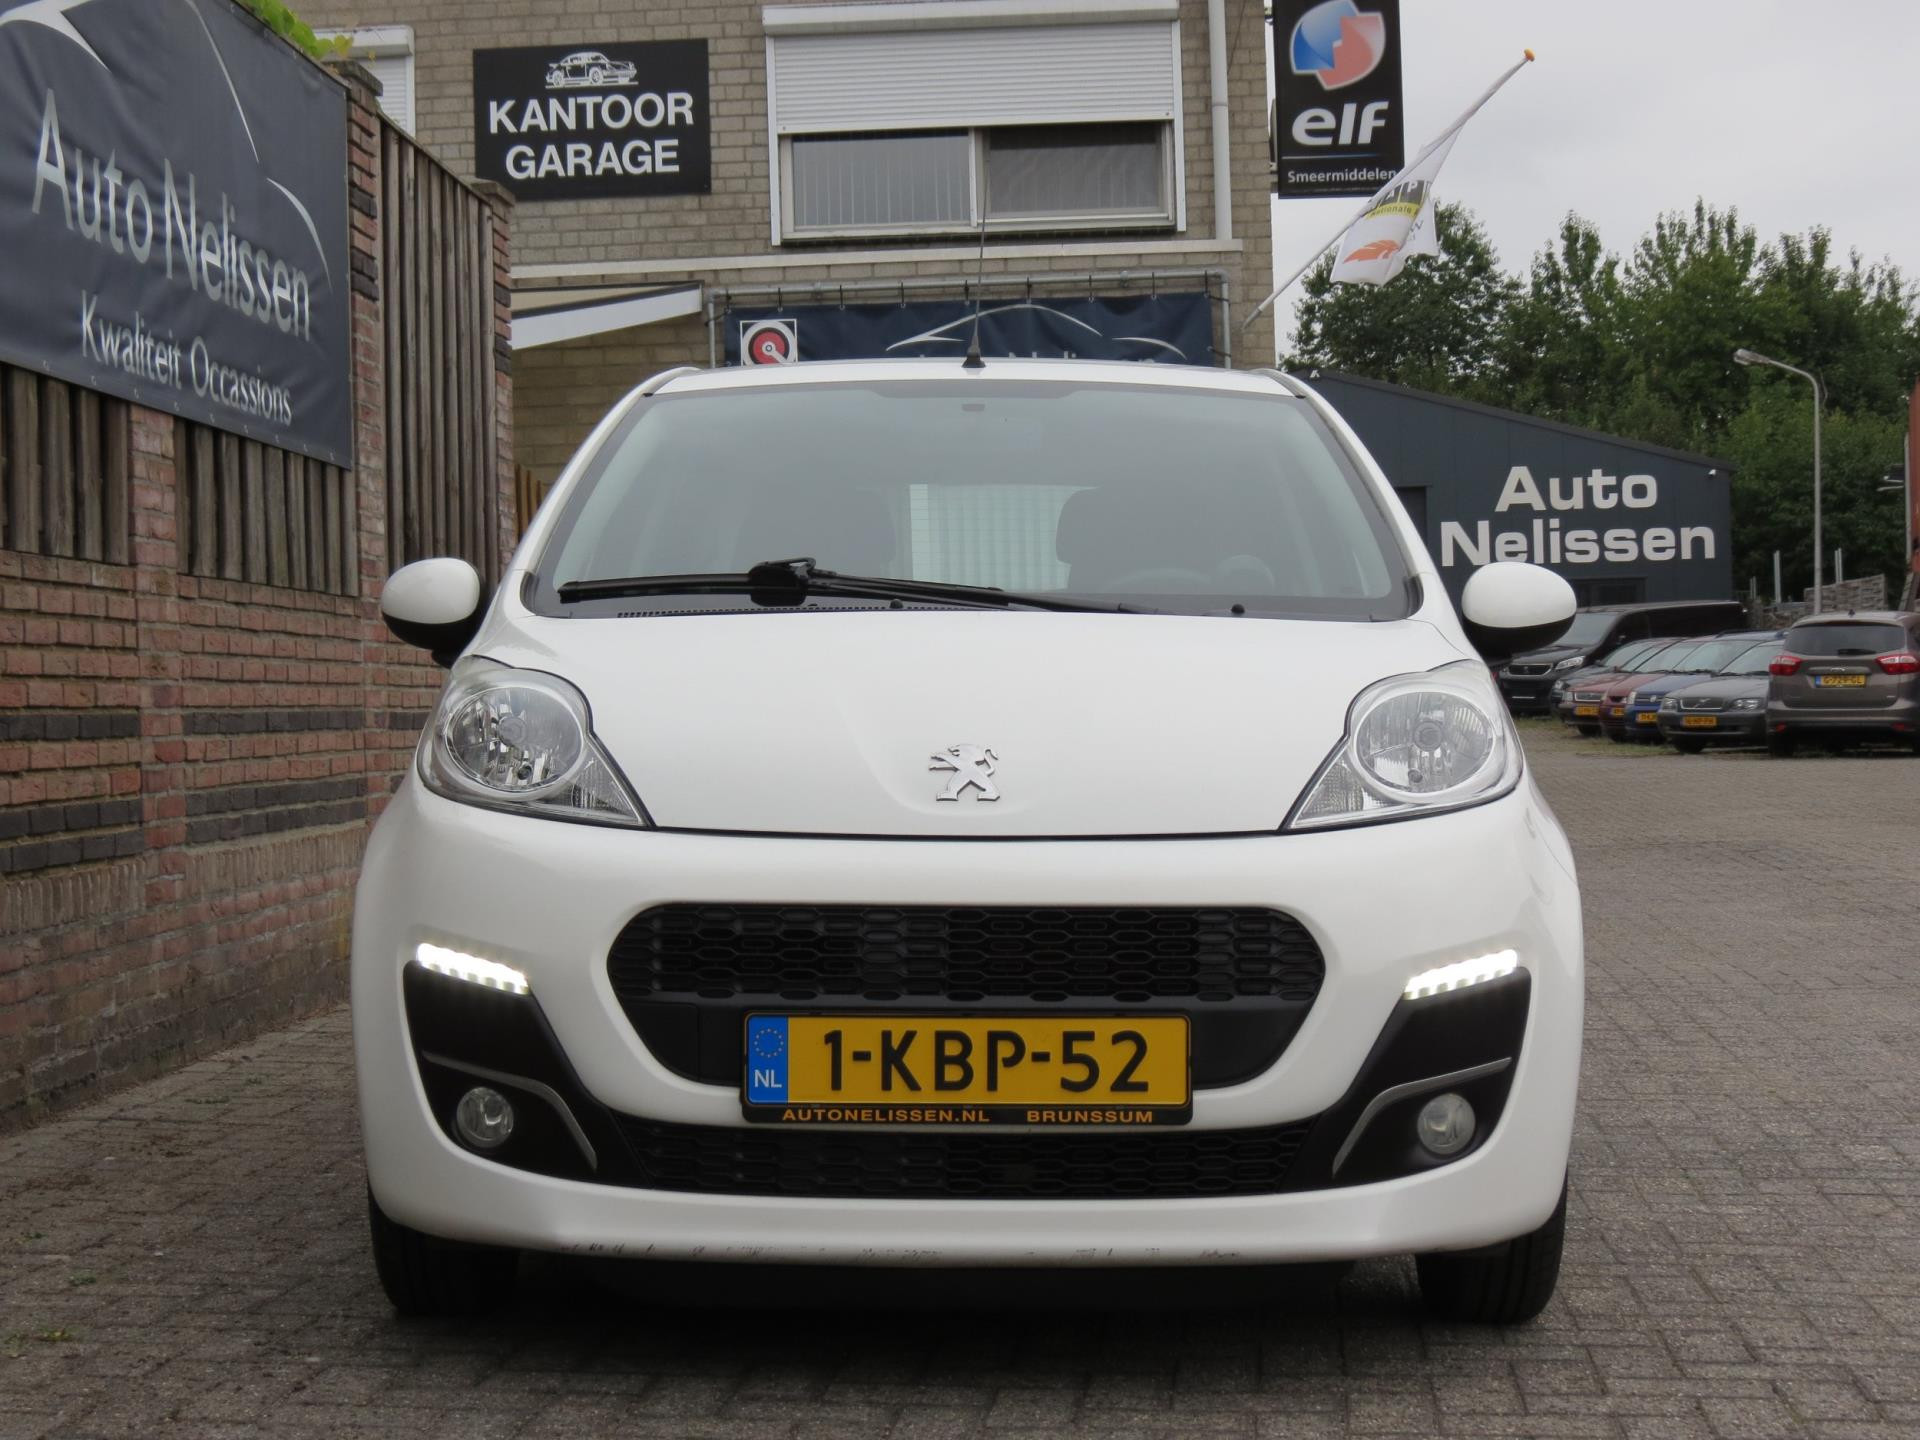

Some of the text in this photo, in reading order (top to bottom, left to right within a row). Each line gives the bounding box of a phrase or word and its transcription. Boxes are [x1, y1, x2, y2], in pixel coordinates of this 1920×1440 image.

[489, 91, 694, 135] KANTOOR
[1291, 101, 1389, 146] elf
[505, 139, 680, 180] GARAGE
[1287, 167, 1397, 184] Smeermiddelen
[81, 288, 292, 427] Kwaliteit Occassions
[1494, 465, 1658, 513] Auto
[1440, 518, 1716, 568] Nelissen
[754, 1068, 783, 1089] NL
[824, 1029, 1149, 1093] 1-KBP-52
[782, 1108, 1153, 1123] AUTONELISSEN.NL BRUNSSUM
